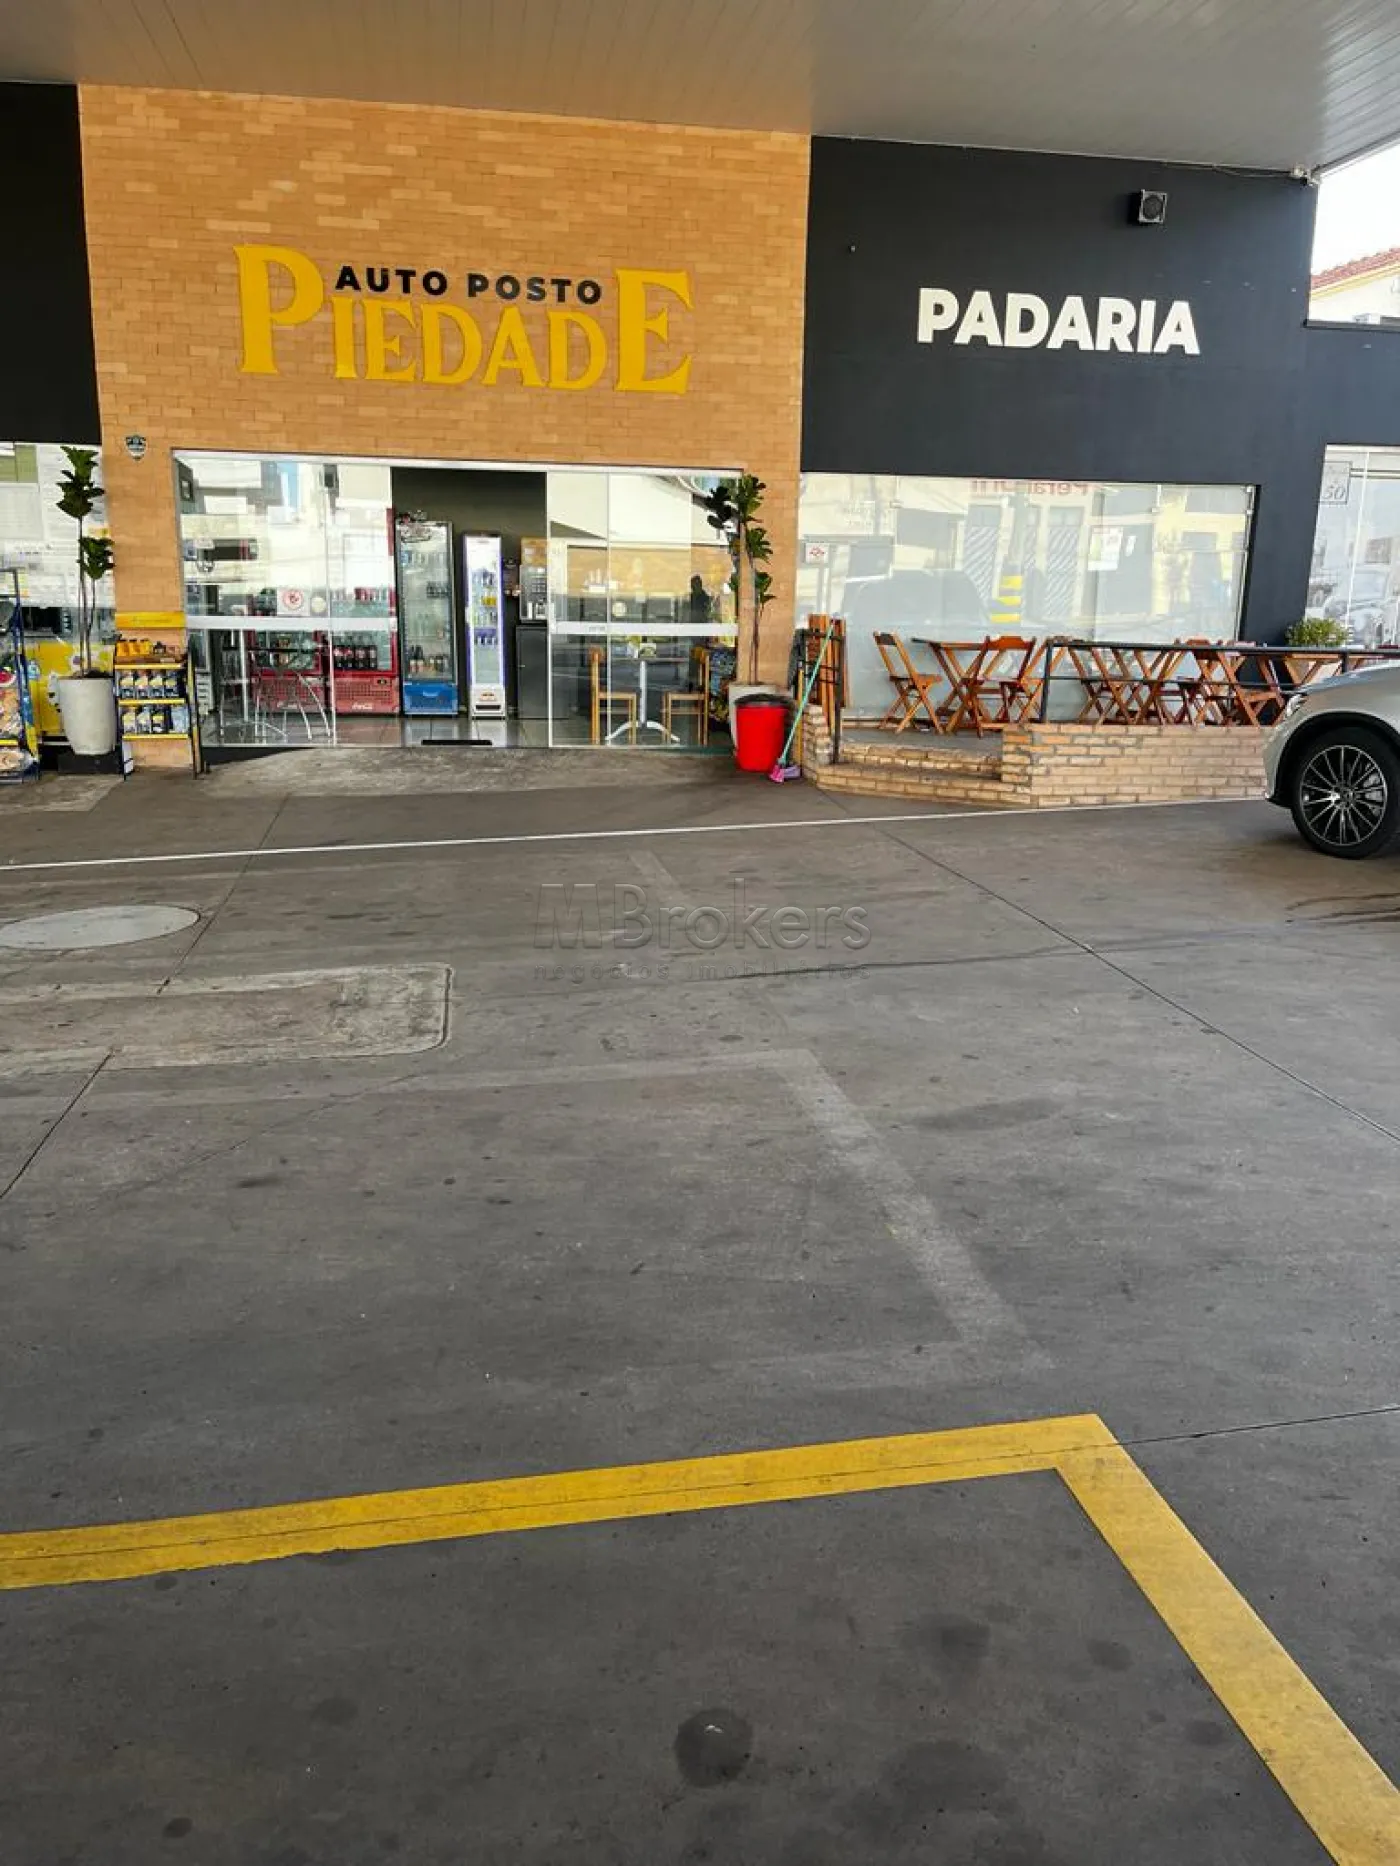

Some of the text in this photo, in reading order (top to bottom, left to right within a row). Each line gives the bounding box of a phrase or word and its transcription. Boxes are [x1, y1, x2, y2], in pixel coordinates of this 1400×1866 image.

[232, 243, 694, 394] PIEDADE
[335, 264, 603, 305] AUTO POSTO
[916, 286, 1201, 356] PADARIA
